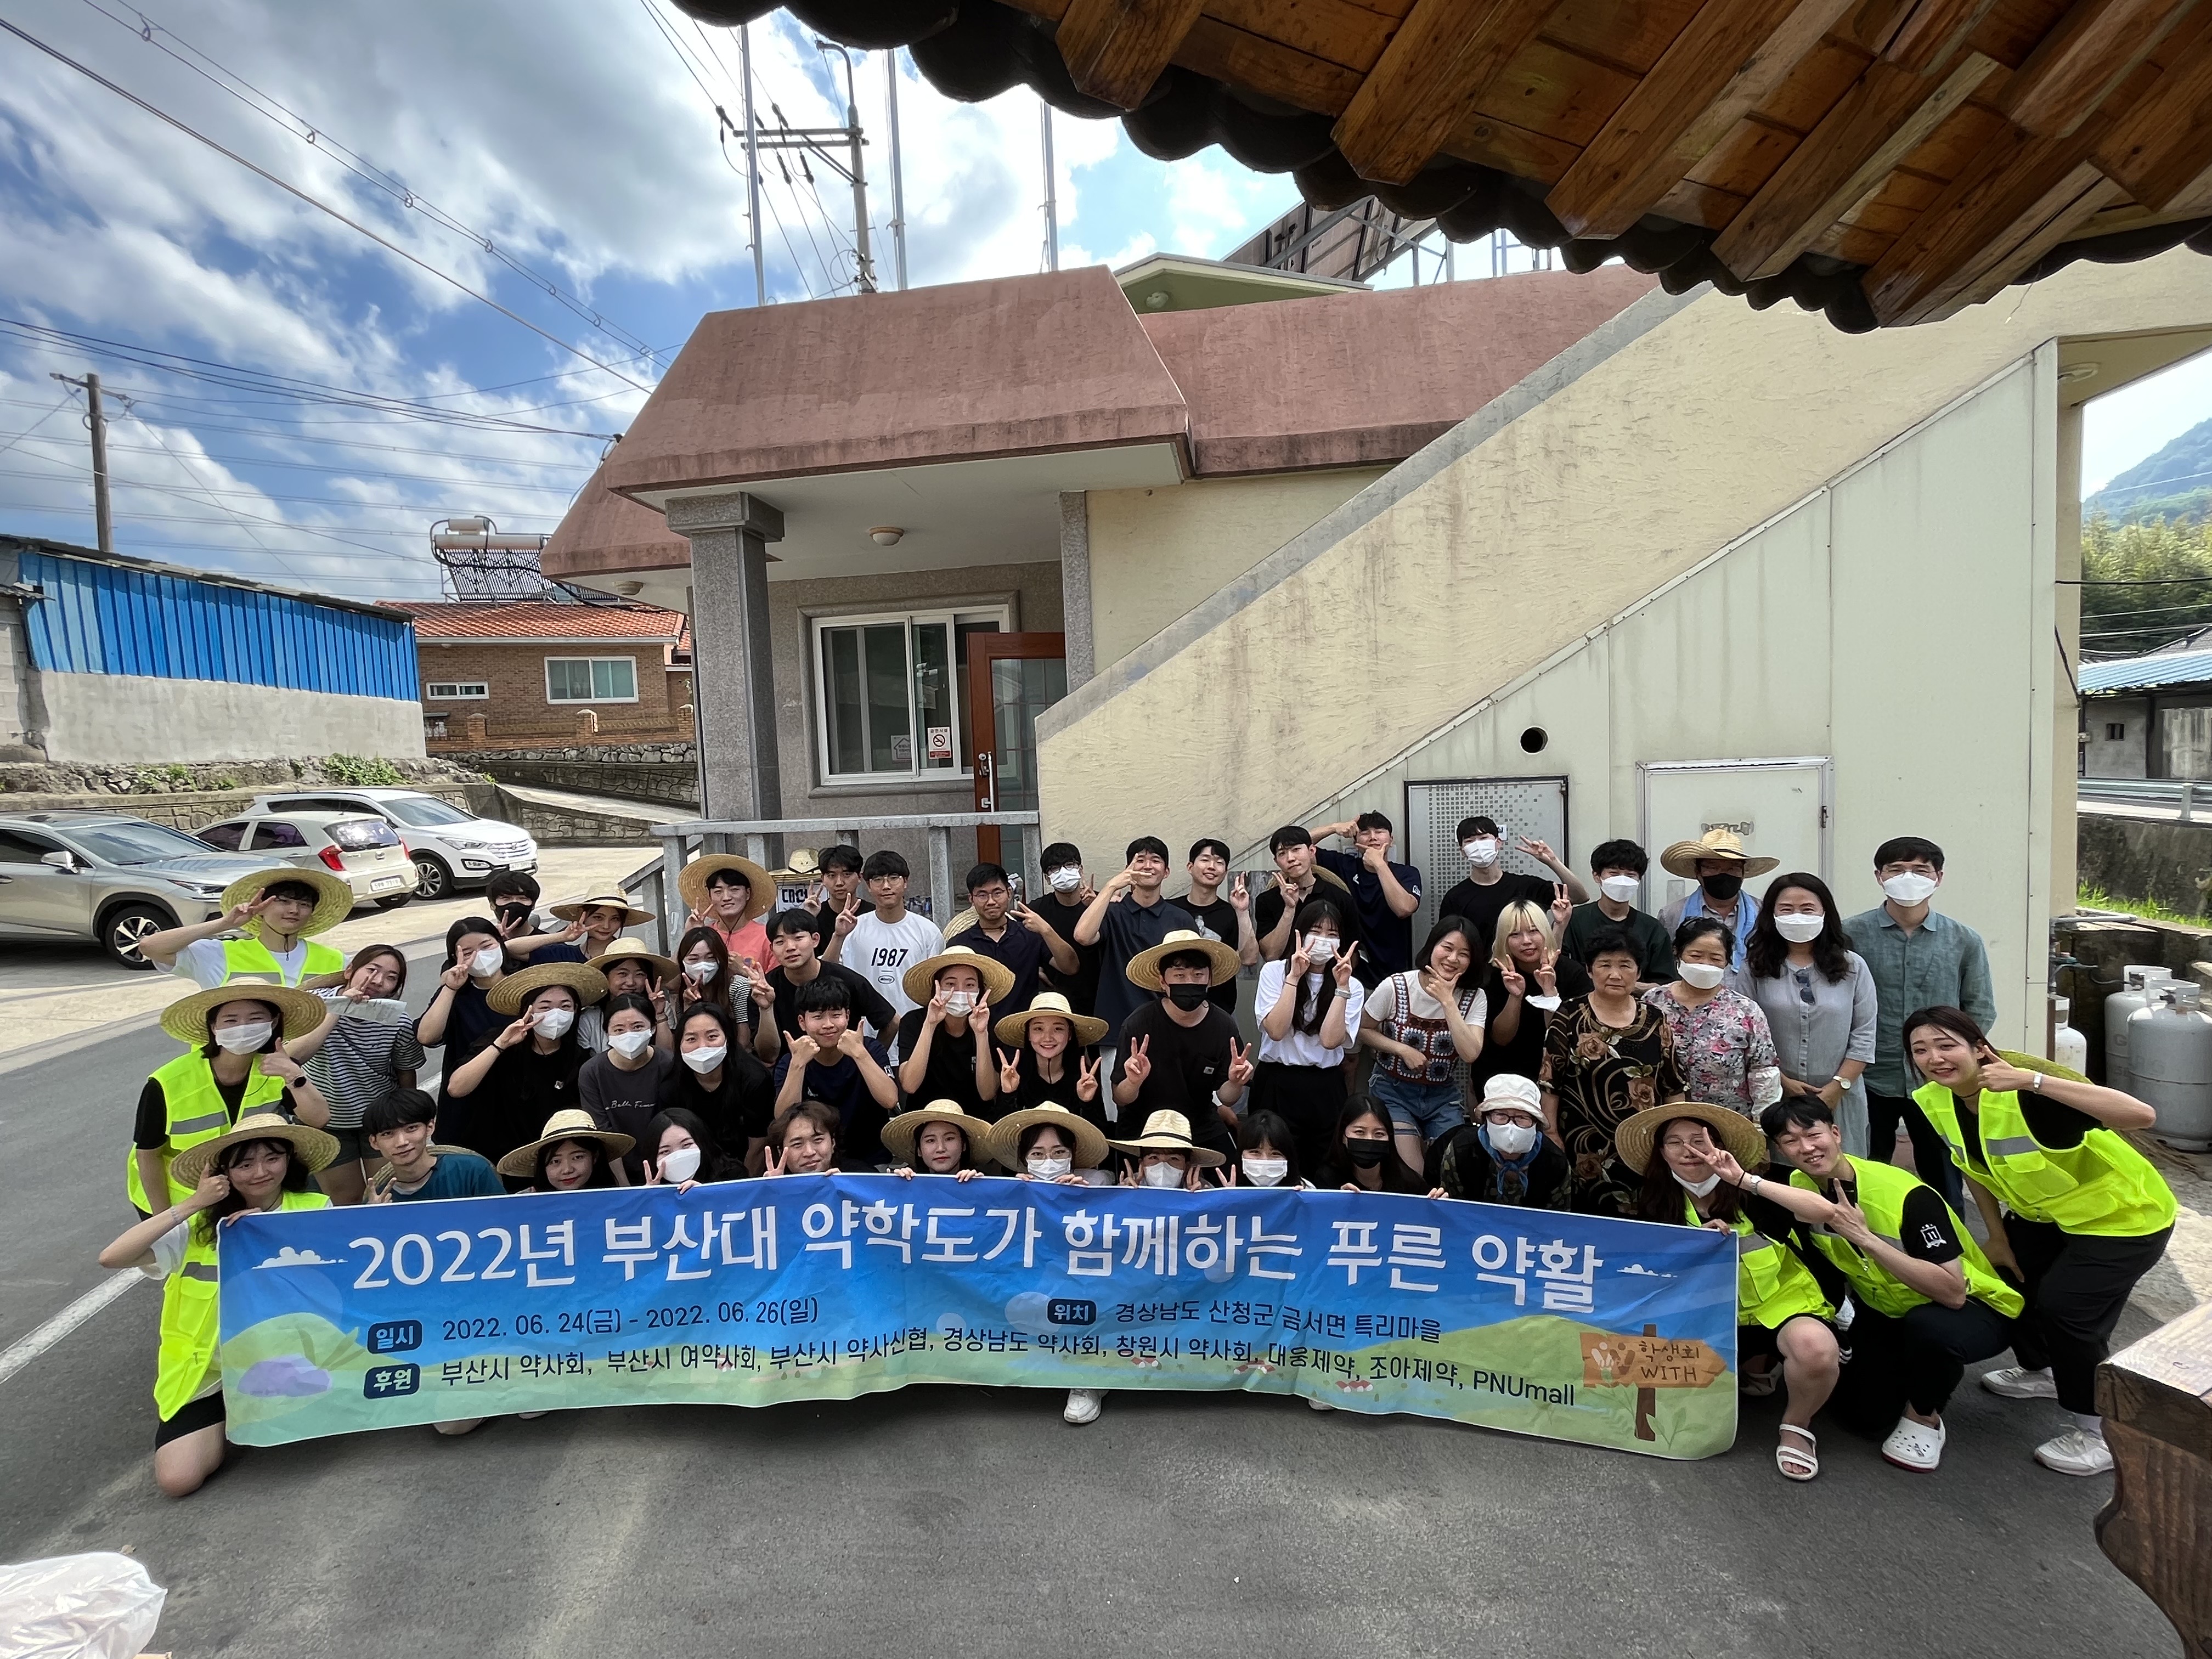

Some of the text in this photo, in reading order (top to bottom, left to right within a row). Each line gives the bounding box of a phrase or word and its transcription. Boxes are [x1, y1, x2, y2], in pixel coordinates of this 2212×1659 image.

[871, 947, 909, 967] 1987
[349, 1199, 1604, 1313] 2022년 부산대 약학도가 함께하는 푸른 약활
[443, 1319, 507, 1340] 2022.
[516, 1314, 549, 1336] 06.
[558, 1307, 622, 1334] 24(금)
[647, 1305, 711, 1329] 2022.
[718, 1301, 749, 1323] 06.
[755, 1296, 819, 1325] 26(일)
[1053, 1302, 1090, 1322] 위치
[1115, 1300, 1442, 1344] 경상남도 산청군 금서면 특리마을
[375, 1326, 415, 1350] 일시
[1638, 1340, 1700, 1362] 학생회
[441, 1325, 1576, 1406] 부산시 약사회, 부산시 여약사회, 부산시 약사신협, 경상남도 약사회, 창원시 약사회, 대웅제약, 조아제약, PNUmall
[1640, 1365, 1697, 1382] WITH
[373, 1369, 413, 1392] 후원
